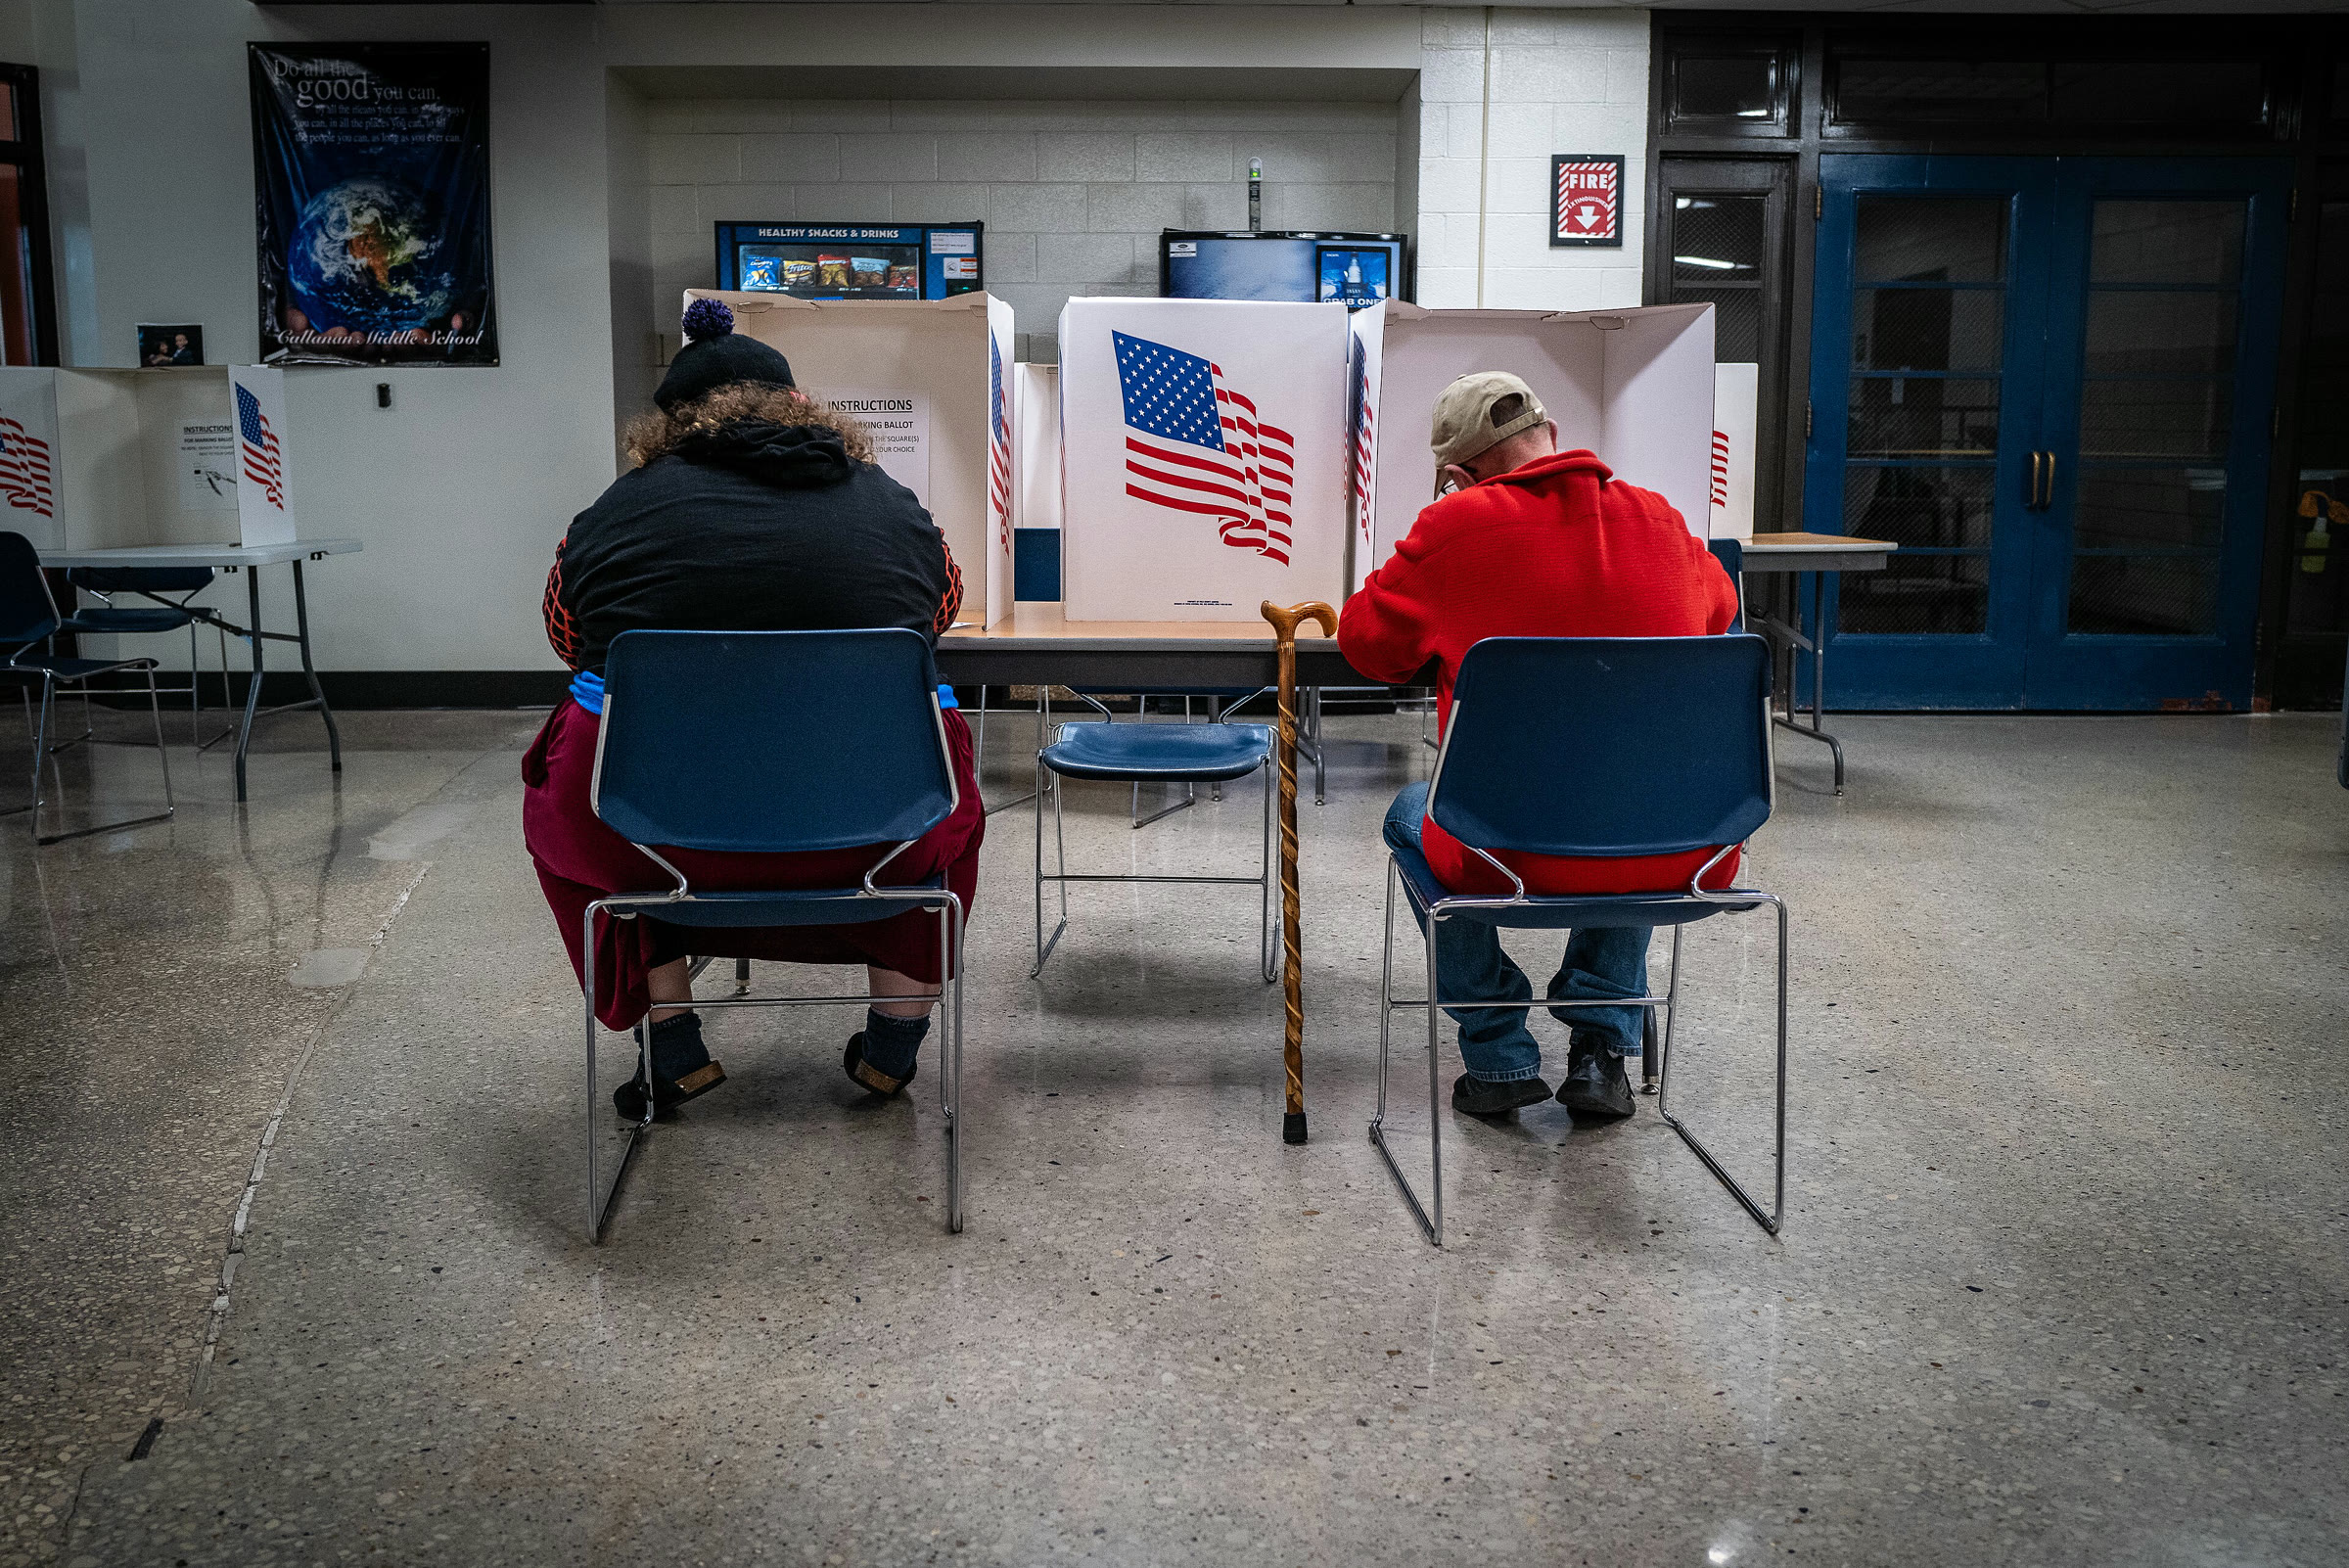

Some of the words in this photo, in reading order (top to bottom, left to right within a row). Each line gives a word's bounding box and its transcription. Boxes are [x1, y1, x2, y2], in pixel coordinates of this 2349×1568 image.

[275, 59, 299, 77] Do
[304, 59, 324, 77] all
[330, 60, 354, 77] the
[297, 72, 368, 107] good
[373, 86, 403, 105] you
[1569, 173, 1608, 189] FIRE
[759, 228, 806, 237] HEALTHY
[807, 229, 849, 238] SNACKS
[850, 229, 858, 238] &
[861, 229, 899, 239] DRINKS
[787, 263, 813, 273] Fritos
[277, 329, 352, 346] Callanan
[356, 329, 418, 346] Middle
[424, 329, 484, 346] School
[828, 399, 913, 411] INSTRUCTIONS
[887, 435, 920, 443] SQUARE(S)
